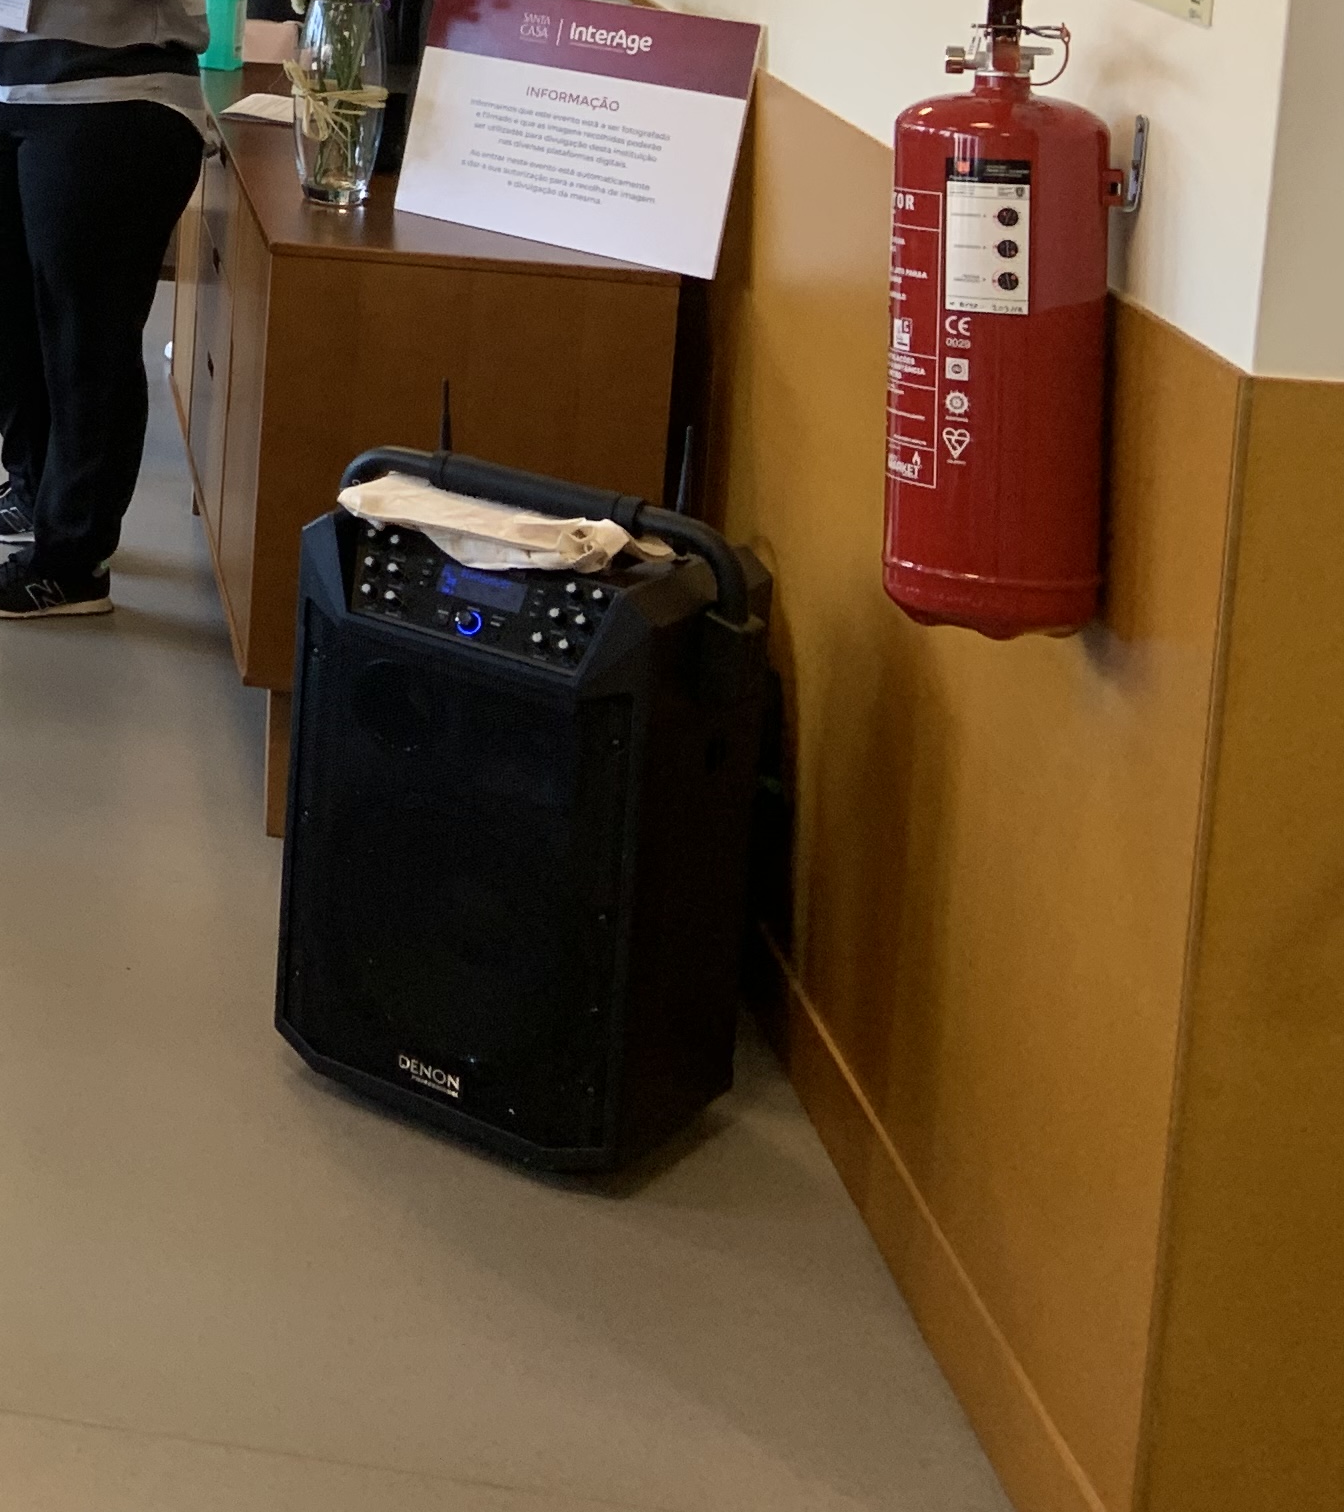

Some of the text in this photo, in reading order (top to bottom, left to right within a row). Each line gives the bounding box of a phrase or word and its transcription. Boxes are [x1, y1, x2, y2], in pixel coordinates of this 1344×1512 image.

[520, 24, 549, 38] CASA
[524, 12, 551, 25] SANTA
[569, 21, 653, 55] InterAge
[525, 85, 620, 112] INFORMAÇÃO
[398, 1054, 460, 1091] DENON
